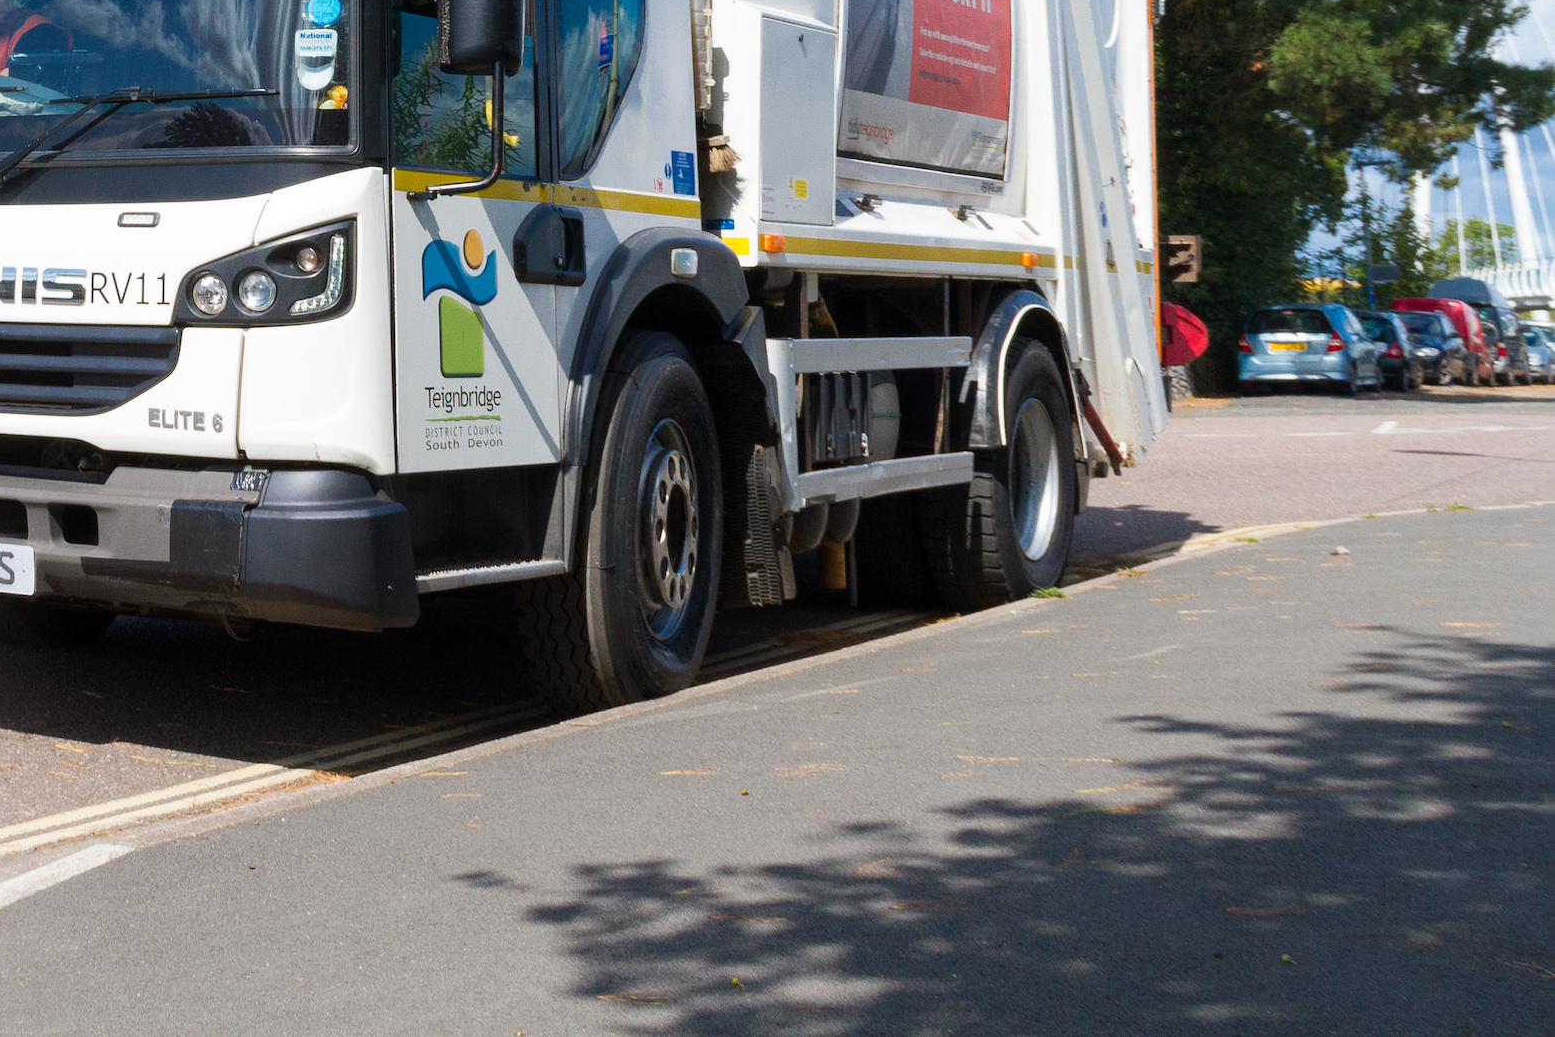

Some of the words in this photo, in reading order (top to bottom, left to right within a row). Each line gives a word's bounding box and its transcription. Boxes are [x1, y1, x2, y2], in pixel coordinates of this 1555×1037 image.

[90, 272, 170, 305] RV11
[425, 385, 501, 413] Teignbridge
[148, 408, 205, 432] ELITE
[212, 413, 223, 433] 6
[425, 426, 463, 438] DISTRICT
[468, 424, 502, 436] COUNCIL
[425, 439, 460, 451] South
[468, 438, 503, 448] Devon
